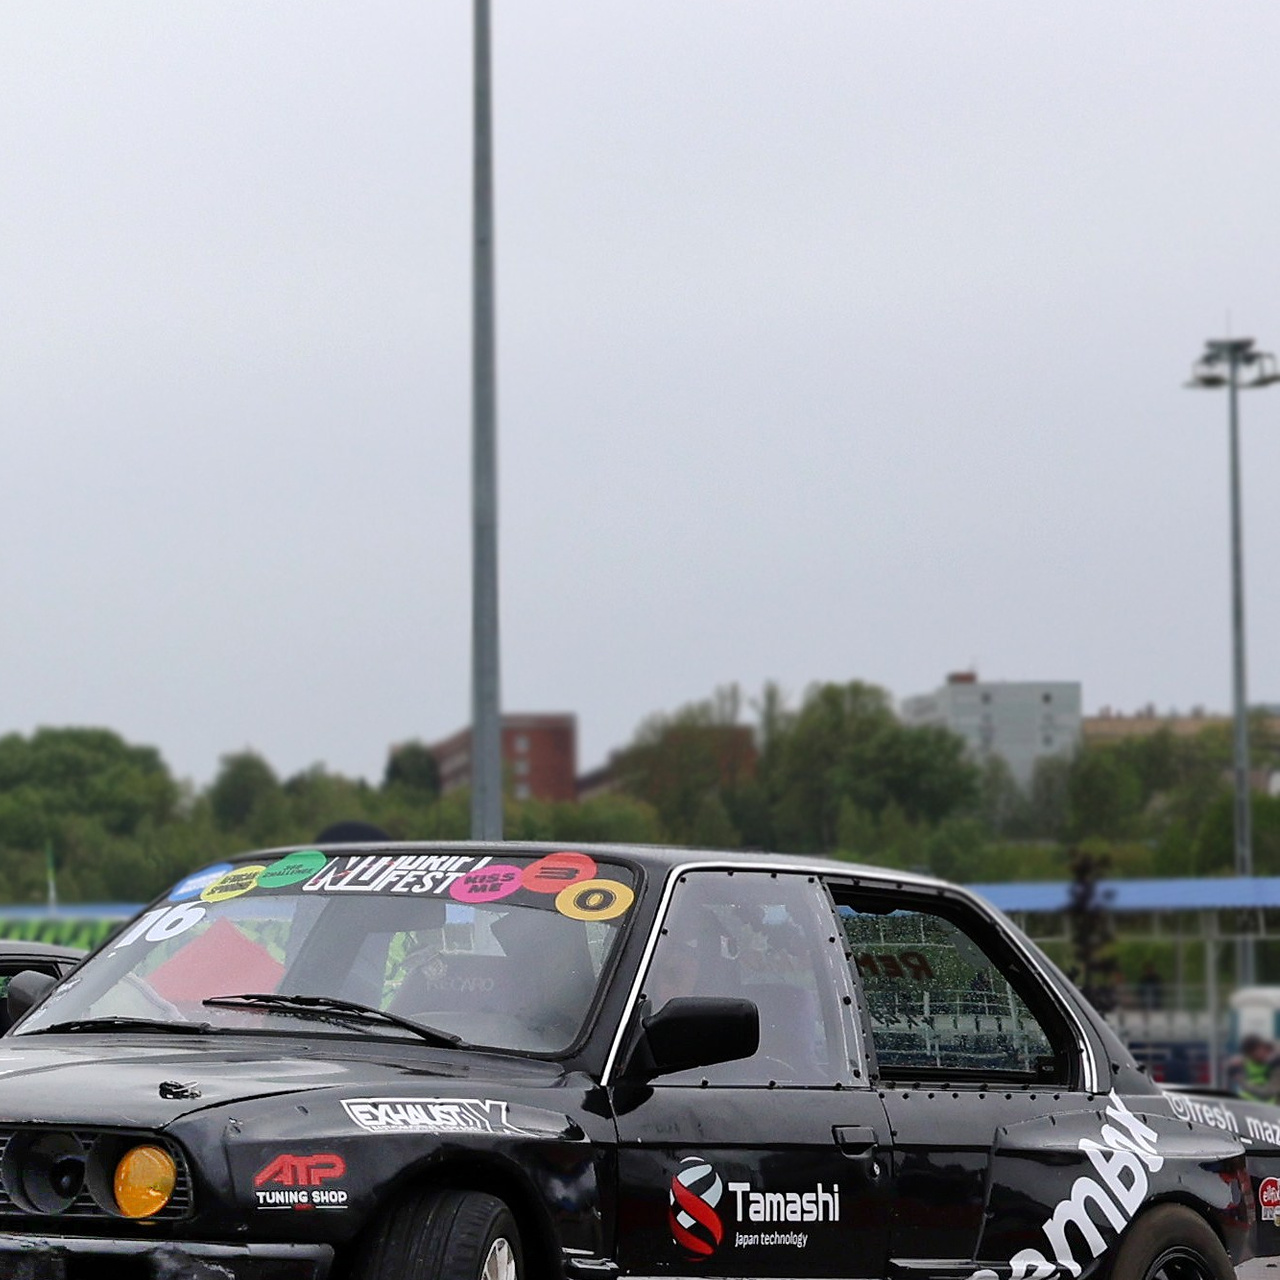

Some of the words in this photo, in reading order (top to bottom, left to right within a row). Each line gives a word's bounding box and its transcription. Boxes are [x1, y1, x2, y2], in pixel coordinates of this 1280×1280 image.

[373, 872, 466, 894] FEST
[464, 872, 516, 885] KISS
[468, 883, 504, 894] ME
[114, 900, 207, 949] 16
[349, 1103, 463, 1126] EXHAUST
[254, 1153, 347, 1187] ATP
[256, 1190, 309, 1204] TUNING
[311, 1190, 348, 1204] SHOP
[727, 1181, 840, 1222] Tamashi
[735, 1231, 759, 1248] Japan
[760, 1231, 808, 1248] technology
